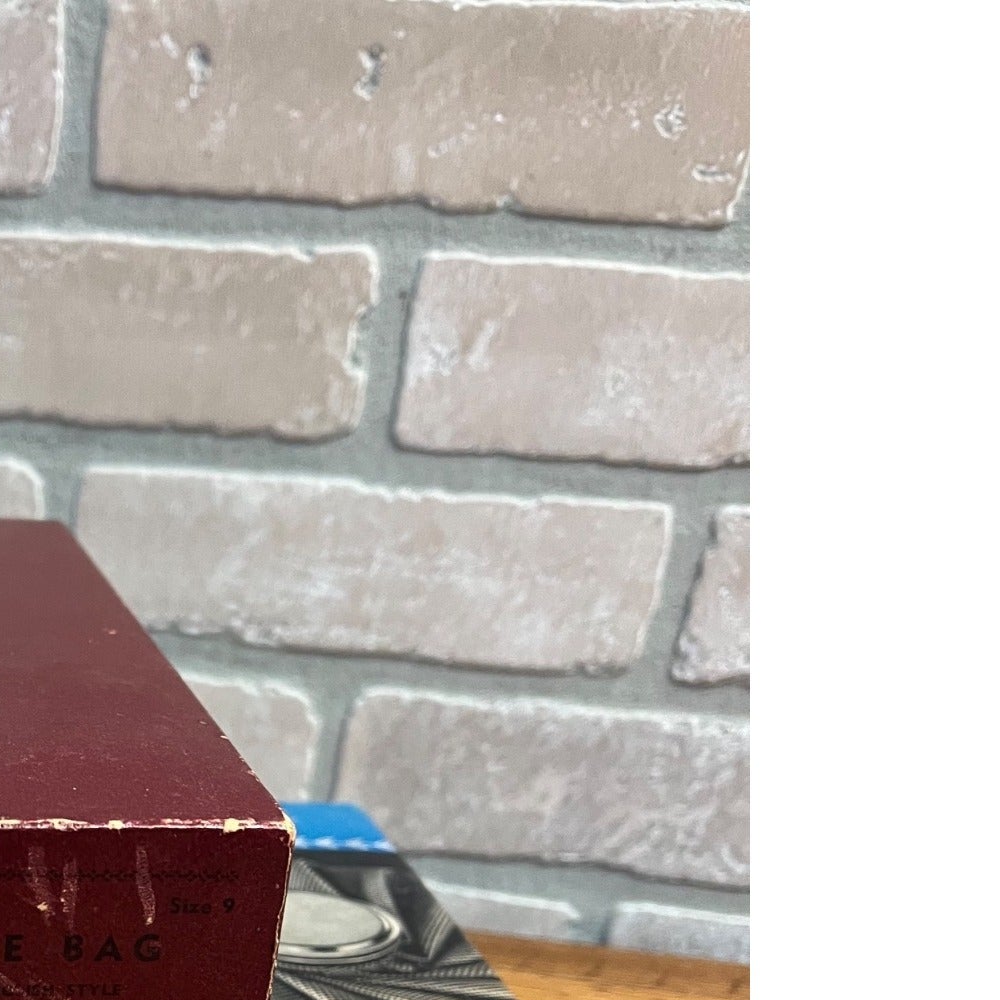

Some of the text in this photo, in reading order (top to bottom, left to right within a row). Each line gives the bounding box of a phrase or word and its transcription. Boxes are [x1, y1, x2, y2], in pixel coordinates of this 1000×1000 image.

[169, 896, 236, 914] Size 9
[63, 933, 162, 962] BAG
[66, 983, 121, 997] STYLE
